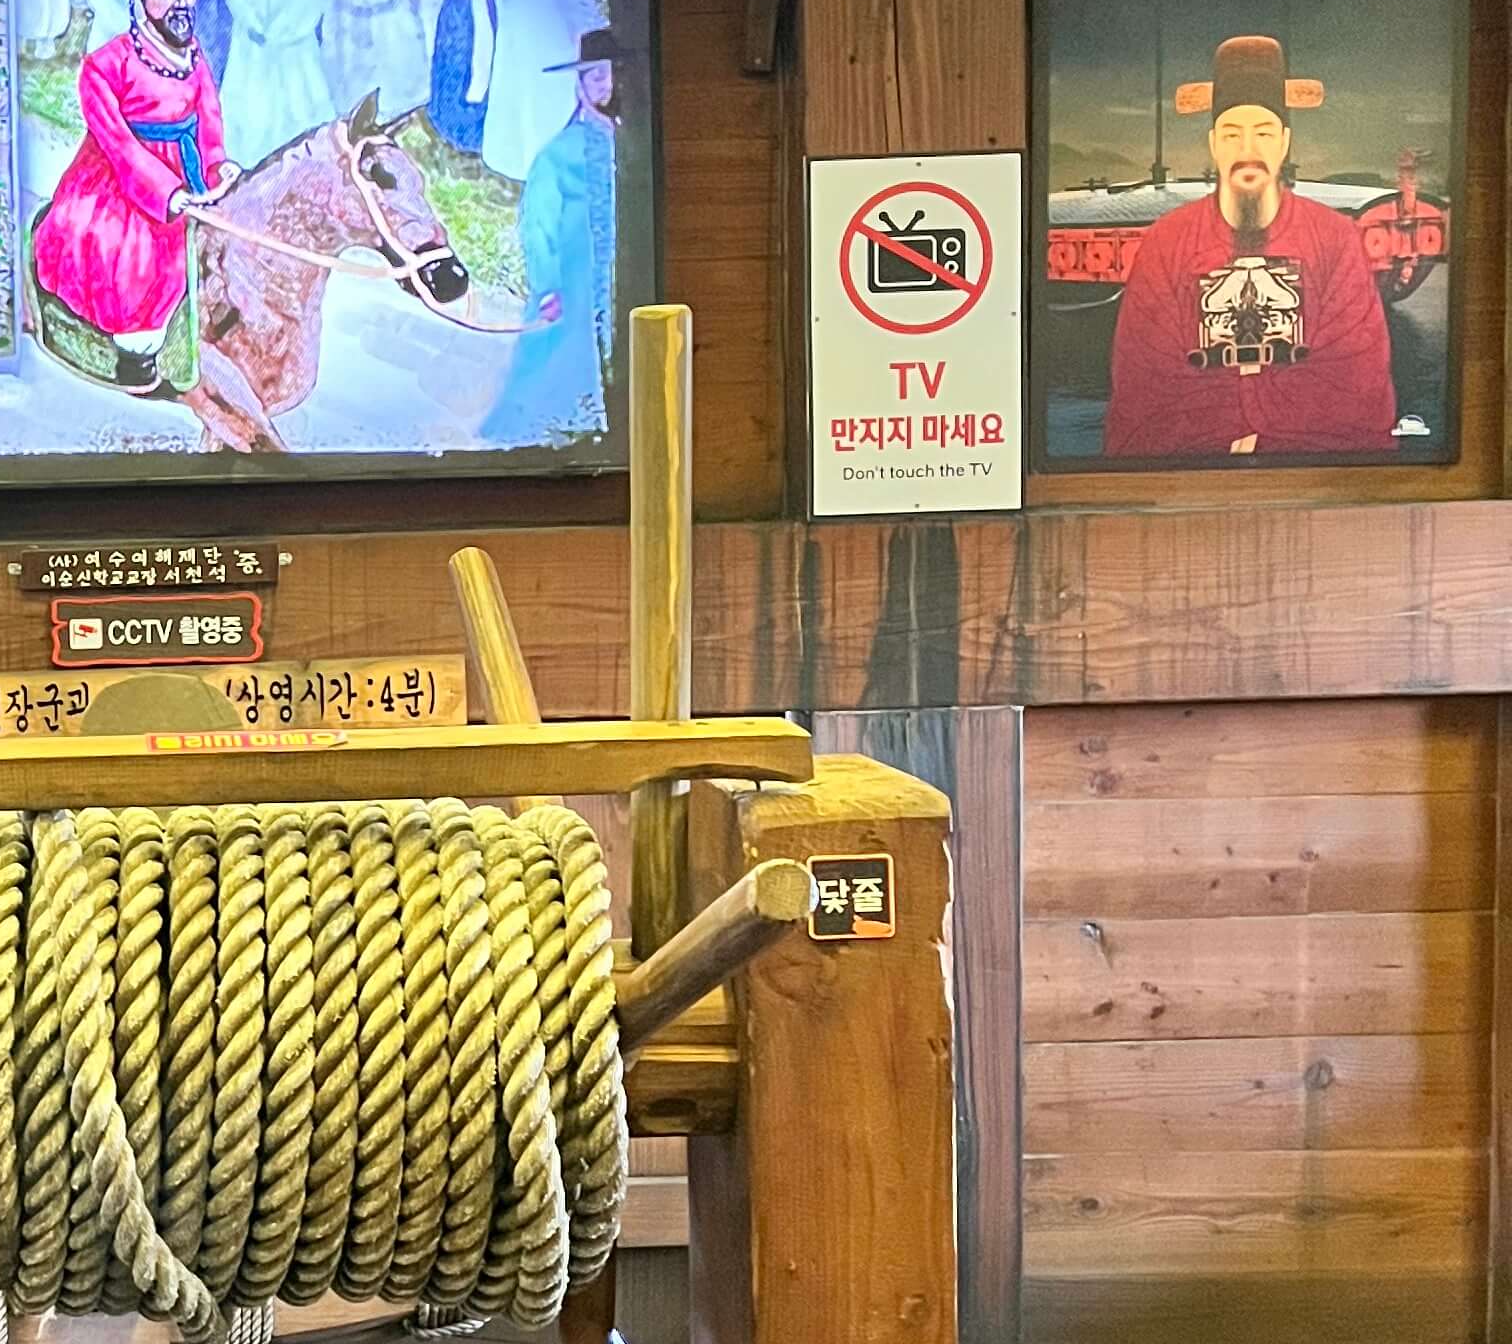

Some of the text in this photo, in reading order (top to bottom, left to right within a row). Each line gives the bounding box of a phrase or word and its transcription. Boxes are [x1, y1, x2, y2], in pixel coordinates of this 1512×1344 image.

[889, 361, 946, 400] TV
[831, 413, 1005, 451] 만지지 마세요
[843, 462, 993, 480] Don't touch the TV
[107, 615, 244, 646] CCTV 촬영중
[816, 877, 885, 915] 닻줄
